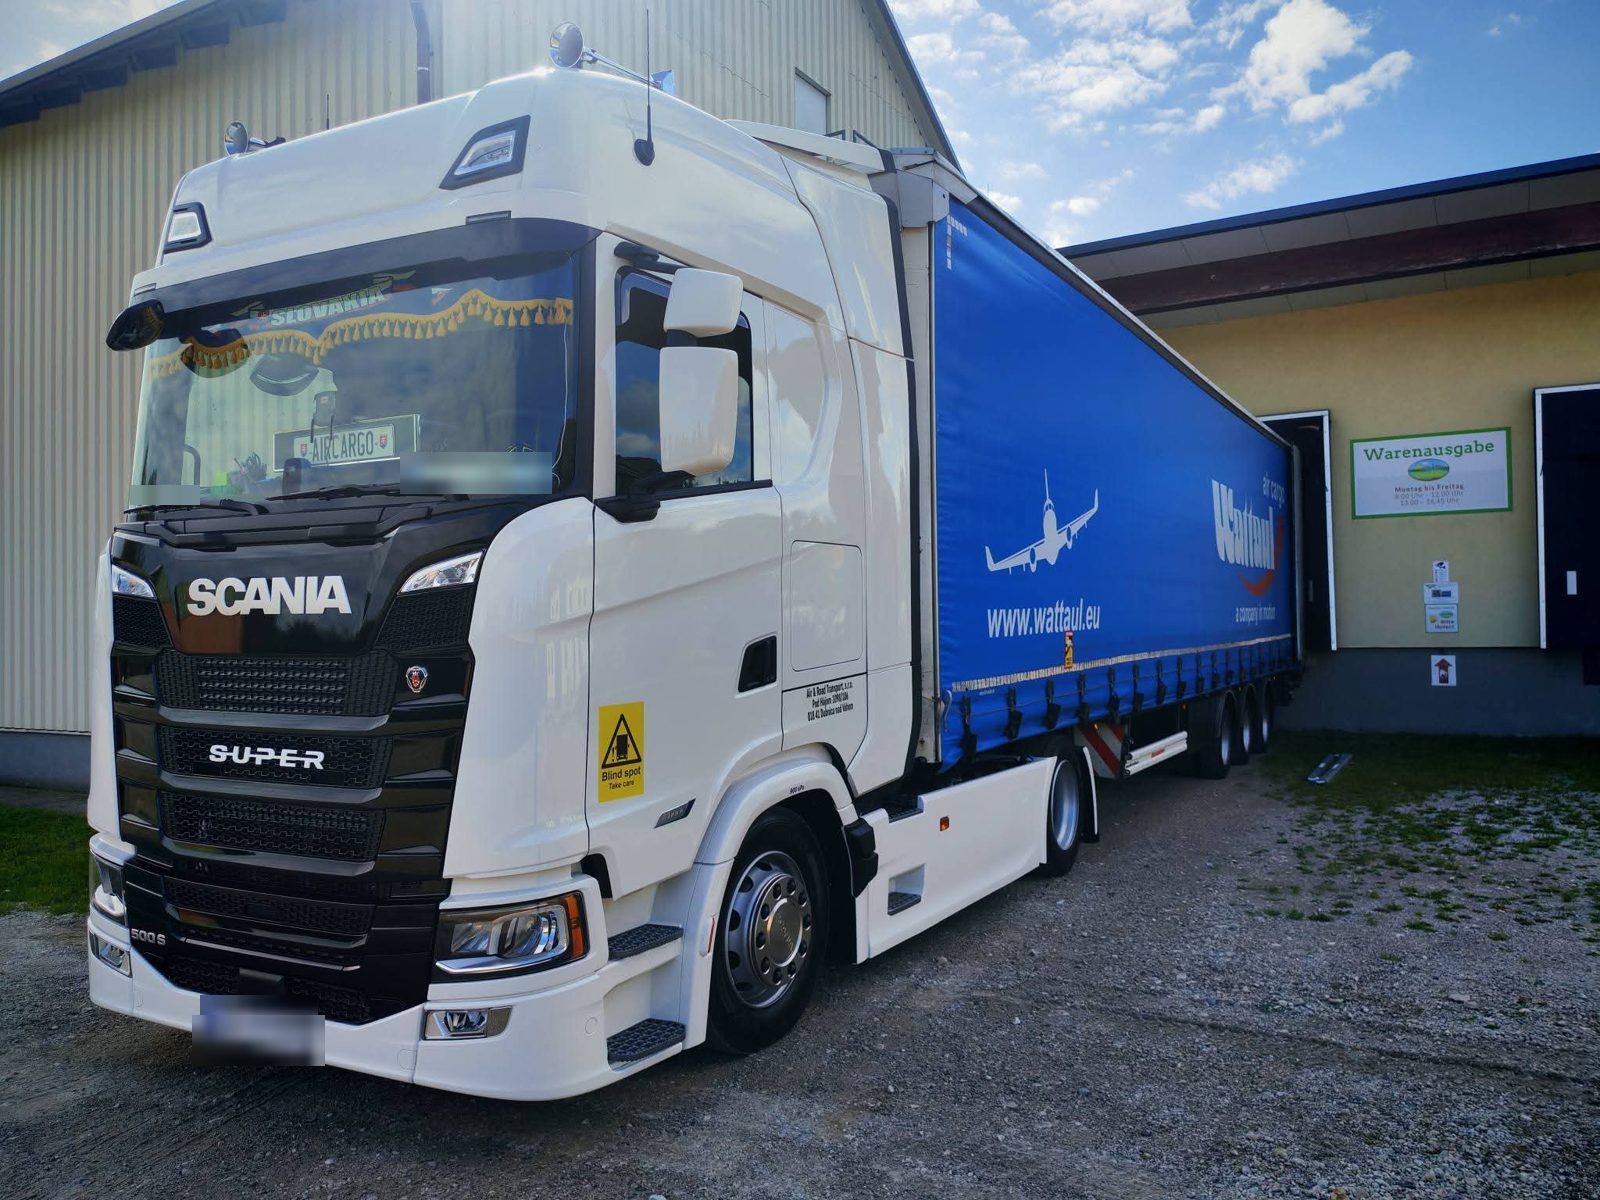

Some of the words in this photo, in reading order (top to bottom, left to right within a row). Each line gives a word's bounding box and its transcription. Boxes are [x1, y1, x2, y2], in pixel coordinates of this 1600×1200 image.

[312, 430, 374, 462] AIRCARGO
[1363, 440, 1495, 461] Warenausgabe
[1262, 472, 1271, 496] air
[187, 575, 352, 617] SCANIA
[987, 598, 1100, 638] www.wattaul.eu
[816, 685, 826, 696] Road
[208, 744, 325, 770] SUPER
[601, 769, 623, 782] Blind
[624, 766, 641, 778] spot
[609, 781, 622, 790] Take
